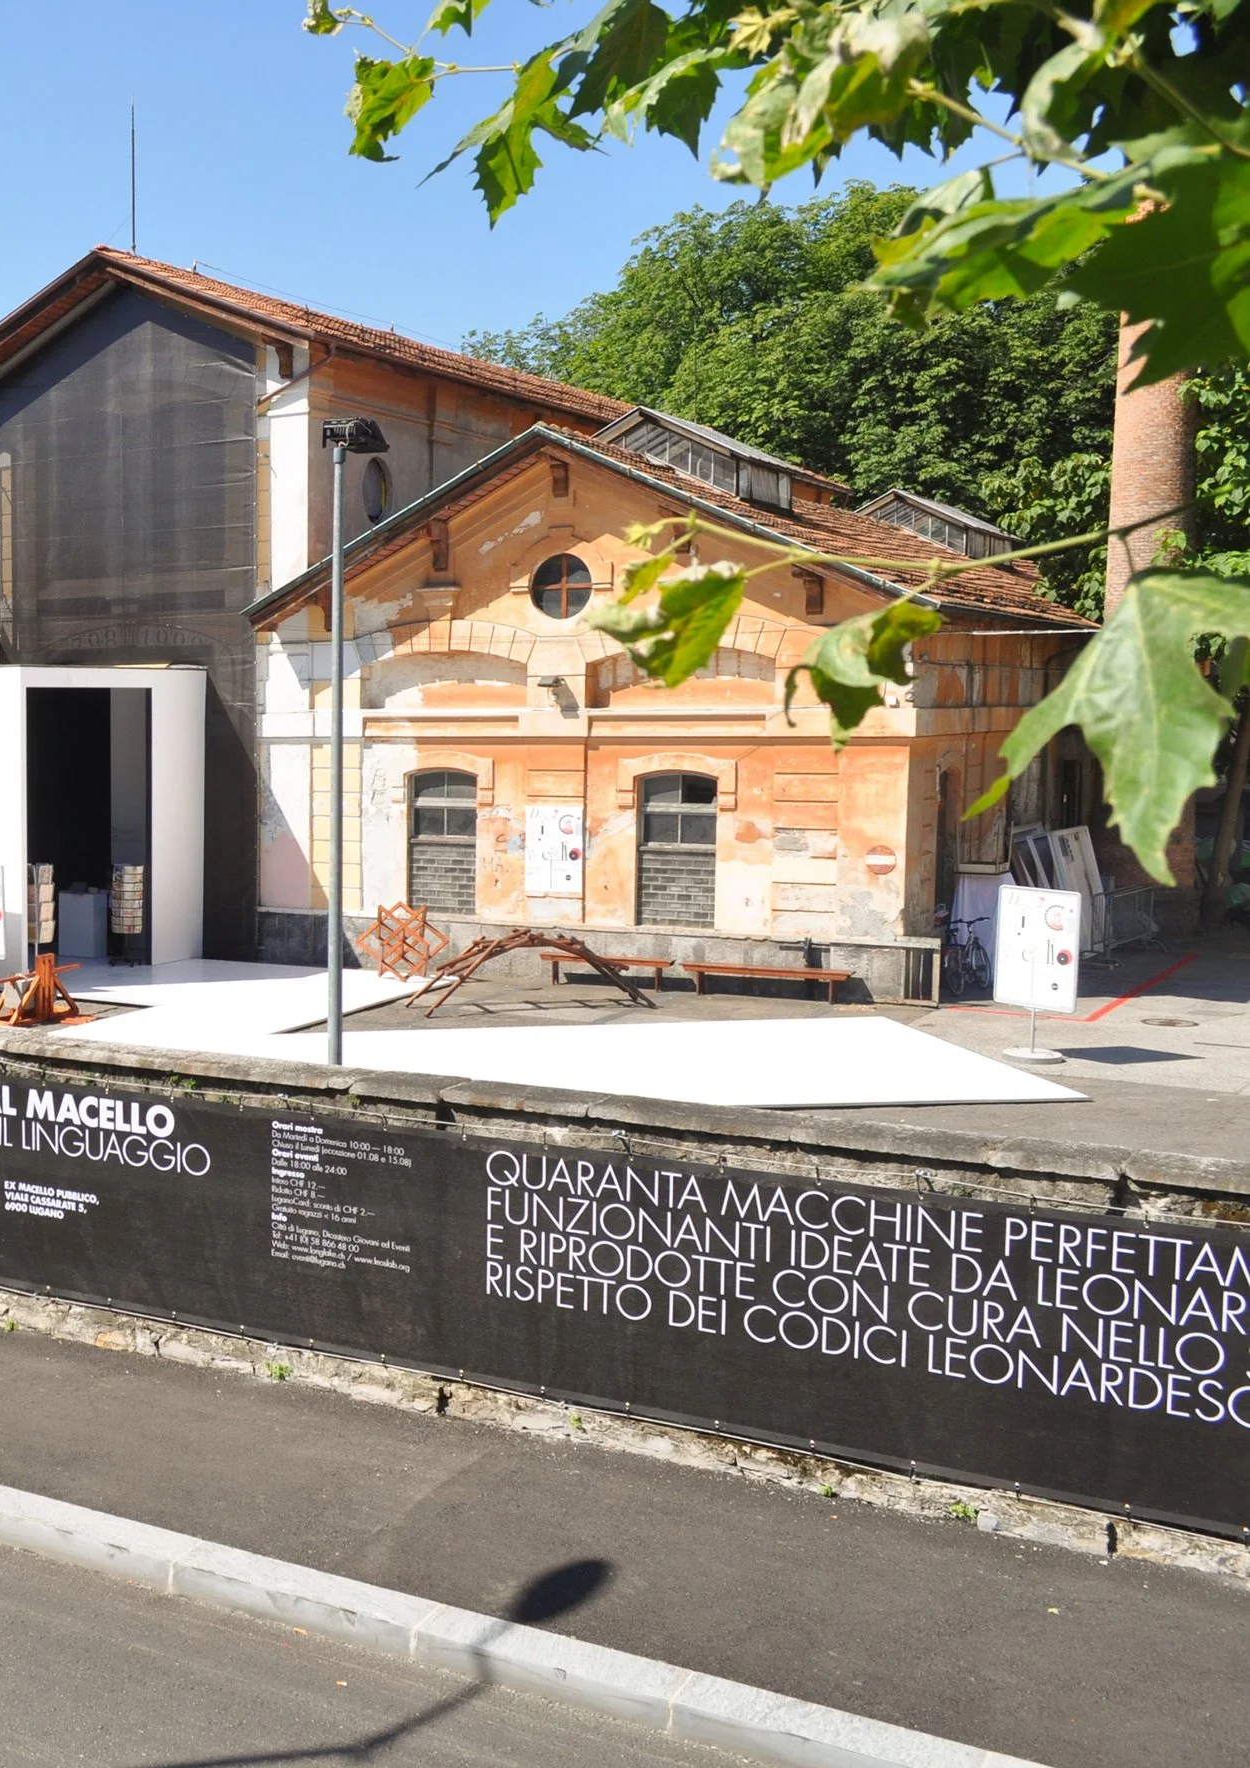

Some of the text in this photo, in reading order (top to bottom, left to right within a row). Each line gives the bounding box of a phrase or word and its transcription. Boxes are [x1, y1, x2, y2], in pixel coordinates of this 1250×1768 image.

[25, 1088, 175, 1138] MACELLO
[272, 1120, 323, 1135] Orari mostra
[21, 1121, 212, 1176] LINGUAGGIO
[272, 1130, 281, 1139] Da
[315, 1136, 347, 1148] Domenica
[350, 1140, 371, 1151] 10:00
[384, 1145, 405, 1156] 18:00
[272, 1139, 294, 1149] Chiuso
[357, 1151, 379, 1162] 01.08
[389, 1155, 411, 1168] 15.08)
[272, 1148, 319, 1162] Orari eventi
[271, 1166, 305, 1179] Ingresso
[272, 1157, 288, 1167] Dalle
[290, 1160, 311, 1170] 18:00
[325, 1165, 347, 1176] 24:00
[290, 1178, 304, 1187] CHF
[4, 1180, 100, 1205] EX MACELLO PUBBLICO,
[294, 1188, 308, 1197] CHF
[4, 1191, 87, 1214] VIALE CASSARATE 5,
[4, 1201, 65, 1220] 6900 LUGANO
[343, 1205, 358, 1215] CHF
[485, 1151, 708, 1214] QUARANTA
[721, 1180, 984, 1254] MACCHINE
[271, 1212, 288, 1222] Info
[331, 1212, 340, 1222] 16
[341, 1216, 357, 1224] anni
[310, 1237, 320, 1246] 58
[322, 1239, 336, 1248] 866
[337, 1243, 347, 1251] 48
[348, 1244, 359, 1253] 00
[353, 1235, 379, 1247] Giovani
[381, 1240, 390, 1249] ed
[391, 1241, 410, 1252] Eventi
[486, 1188, 772, 1264] FUNZIONANTI
[789, 1230, 931, 1290] IDEATE
[951, 1253, 1019, 1301] DA
[486, 1225, 1226, 1376] E RIPRODOTTE CON CURA NELLO
[486, 1261, 652, 1322] RISPETTO
[668, 1290, 727, 1336] DEI
[743, 1305, 907, 1368] CODICI
